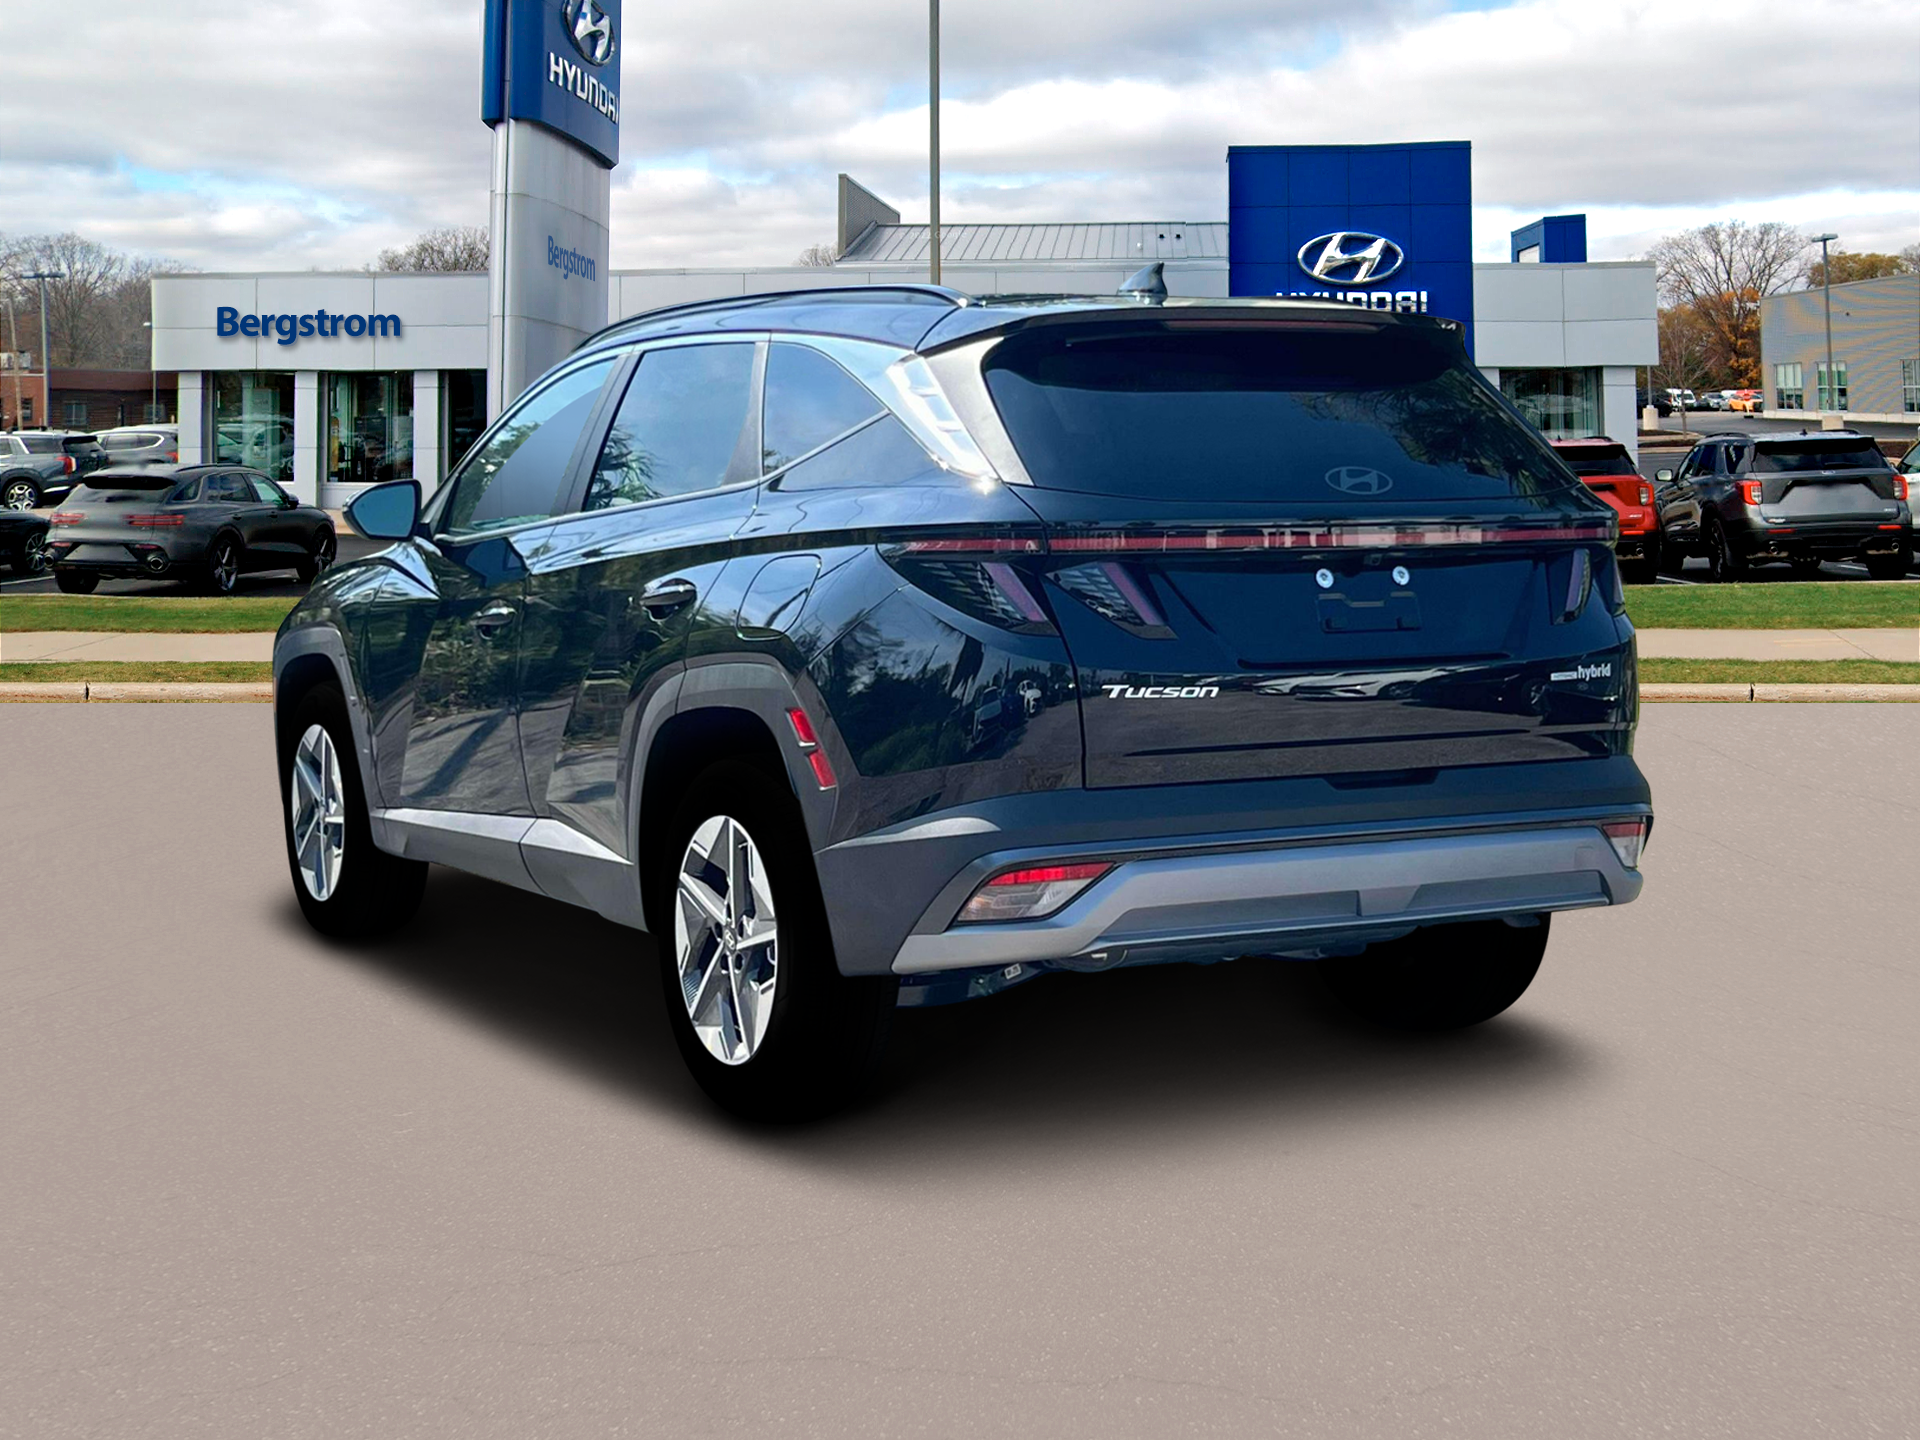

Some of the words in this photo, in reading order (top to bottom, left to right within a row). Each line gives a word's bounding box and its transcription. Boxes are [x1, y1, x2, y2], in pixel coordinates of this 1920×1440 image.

[548, 52, 619, 124] HYUNDAI
[547, 235, 596, 281] Bergstrom
[1276, 290, 1428, 313] NDAI
[217, 306, 401, 346] Bergstrom
[1577, 662, 1612, 682] hybrid
